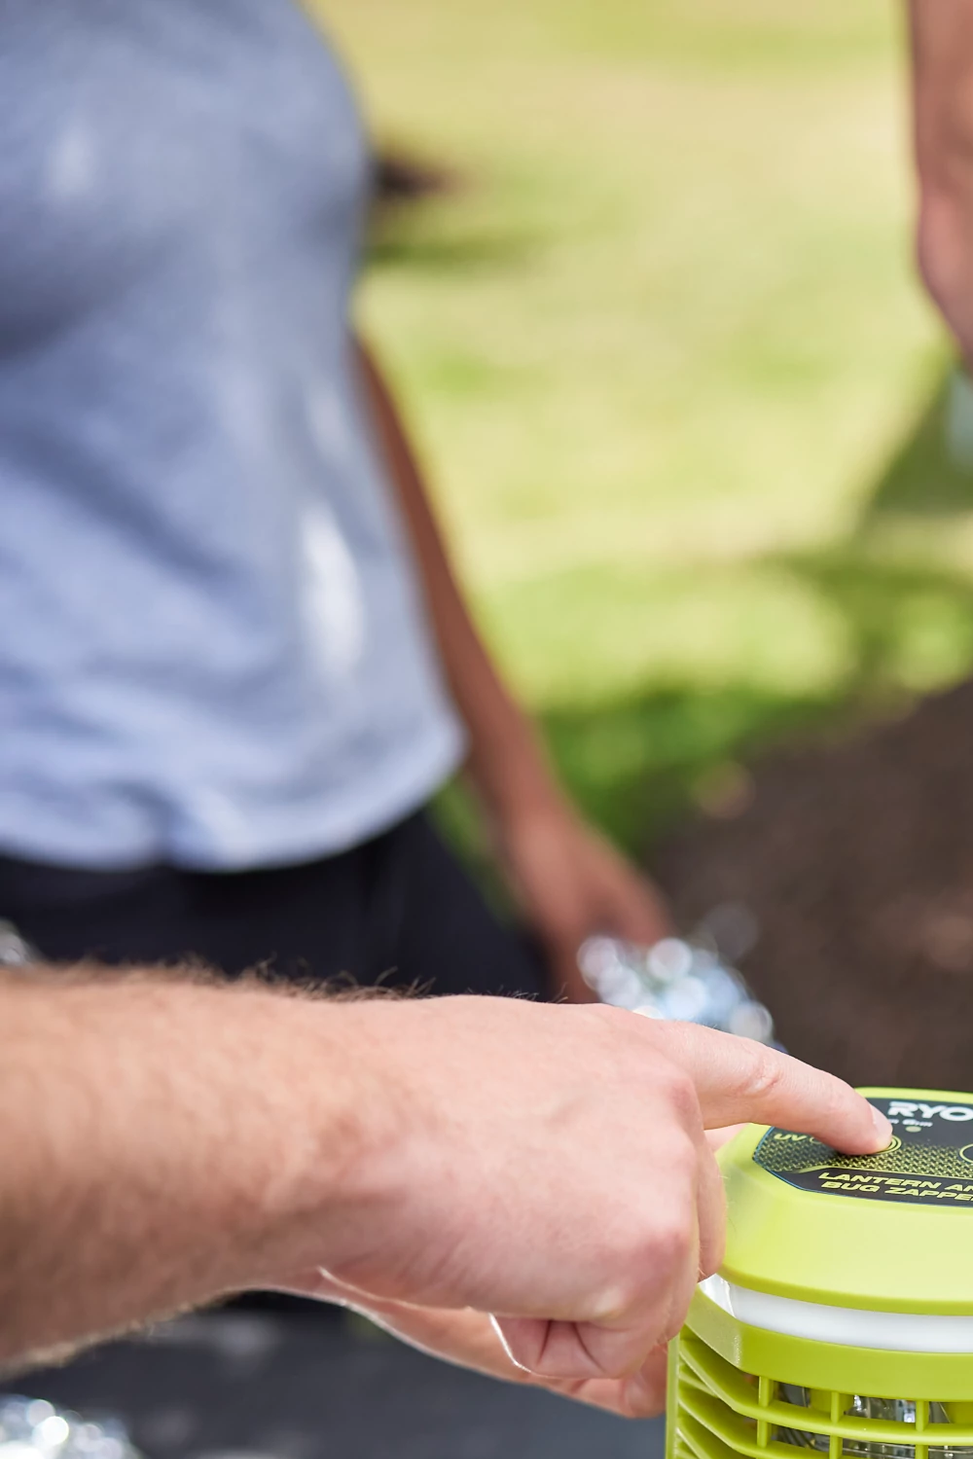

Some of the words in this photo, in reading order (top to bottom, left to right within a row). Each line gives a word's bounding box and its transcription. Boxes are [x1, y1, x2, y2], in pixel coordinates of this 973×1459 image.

[774, 1133, 807, 1142] UV
[818, 1172, 942, 1189] LANTERN
[821, 1181, 878, 1193] BUG
